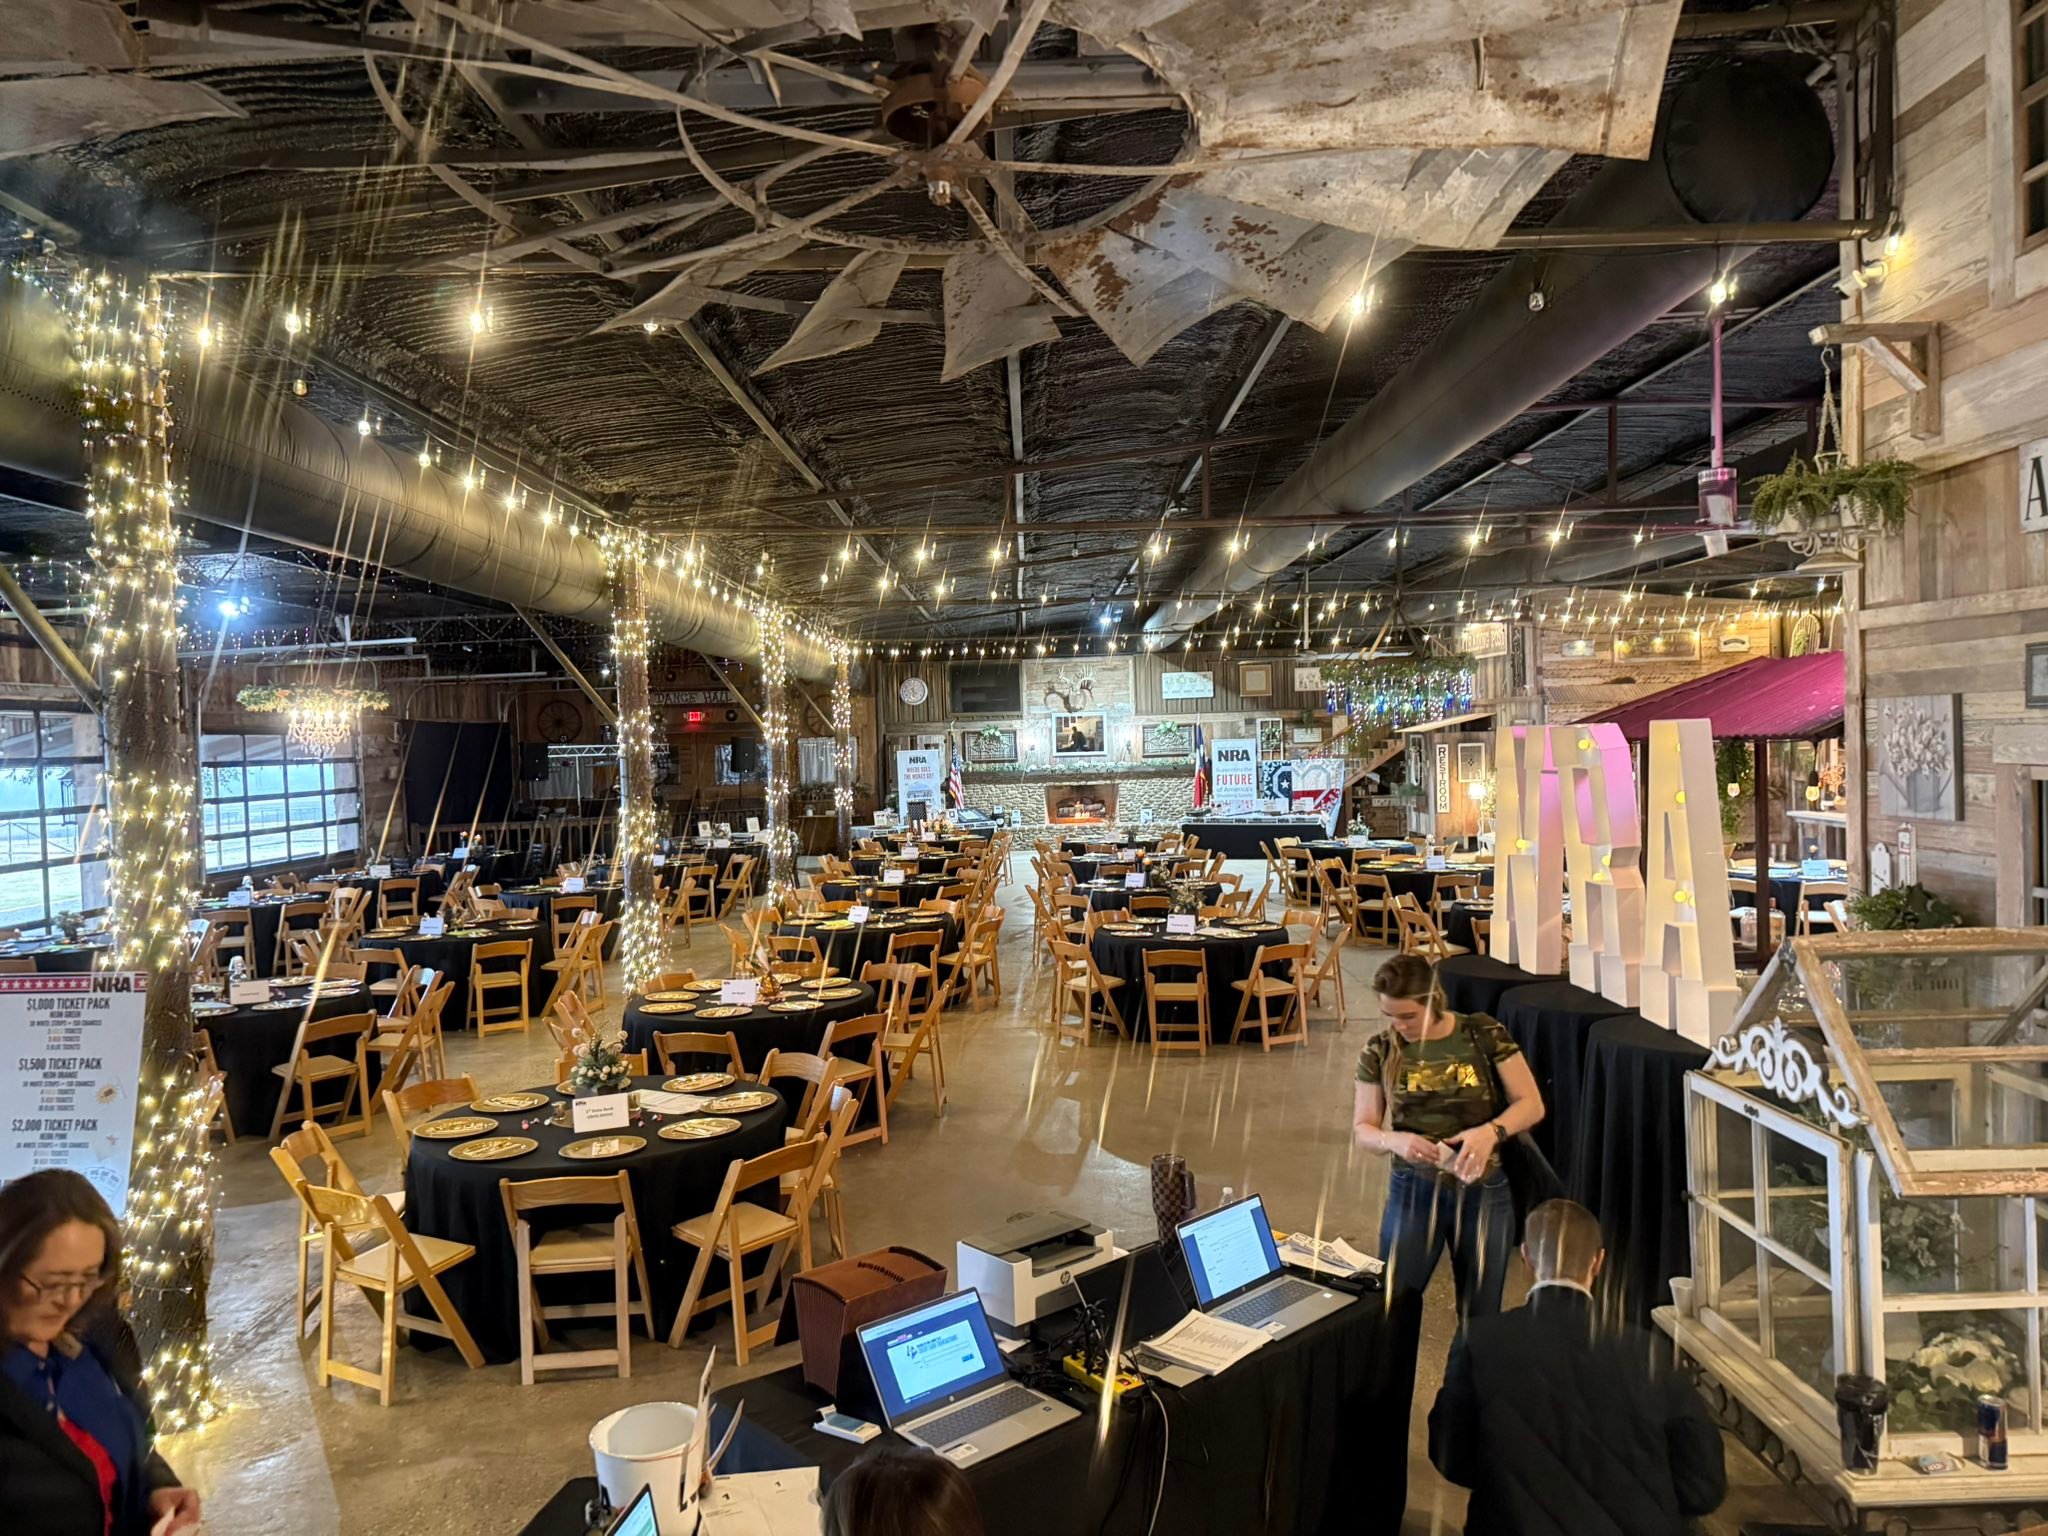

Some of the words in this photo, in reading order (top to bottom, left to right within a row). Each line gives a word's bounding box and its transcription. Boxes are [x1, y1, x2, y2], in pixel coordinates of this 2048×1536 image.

[654, 691, 696, 704] DANCE
[704, 691, 733, 702] HALL
[909, 756, 927, 764] NRA
[1217, 749, 1251, 762] NRA
[1216, 774, 1253, 785] FUTURE
[1438, 746, 1448, 811] RESTROOM
[93, 976, 132, 993] NRA
[27, 997, 55, 1011] $1,000
[56, 997, 86, 1010] TICKET
[87, 997, 111, 1010] PACK
[18, 1057, 47, 1071] $1,500
[48, 1057, 78, 1070] TICKET
[79, 1057, 102, 1070] PACK
[12, 1118, 42, 1132] $2,000
[43, 1118, 73, 1131] TICKET
[74, 1118, 99, 1131] PACK
